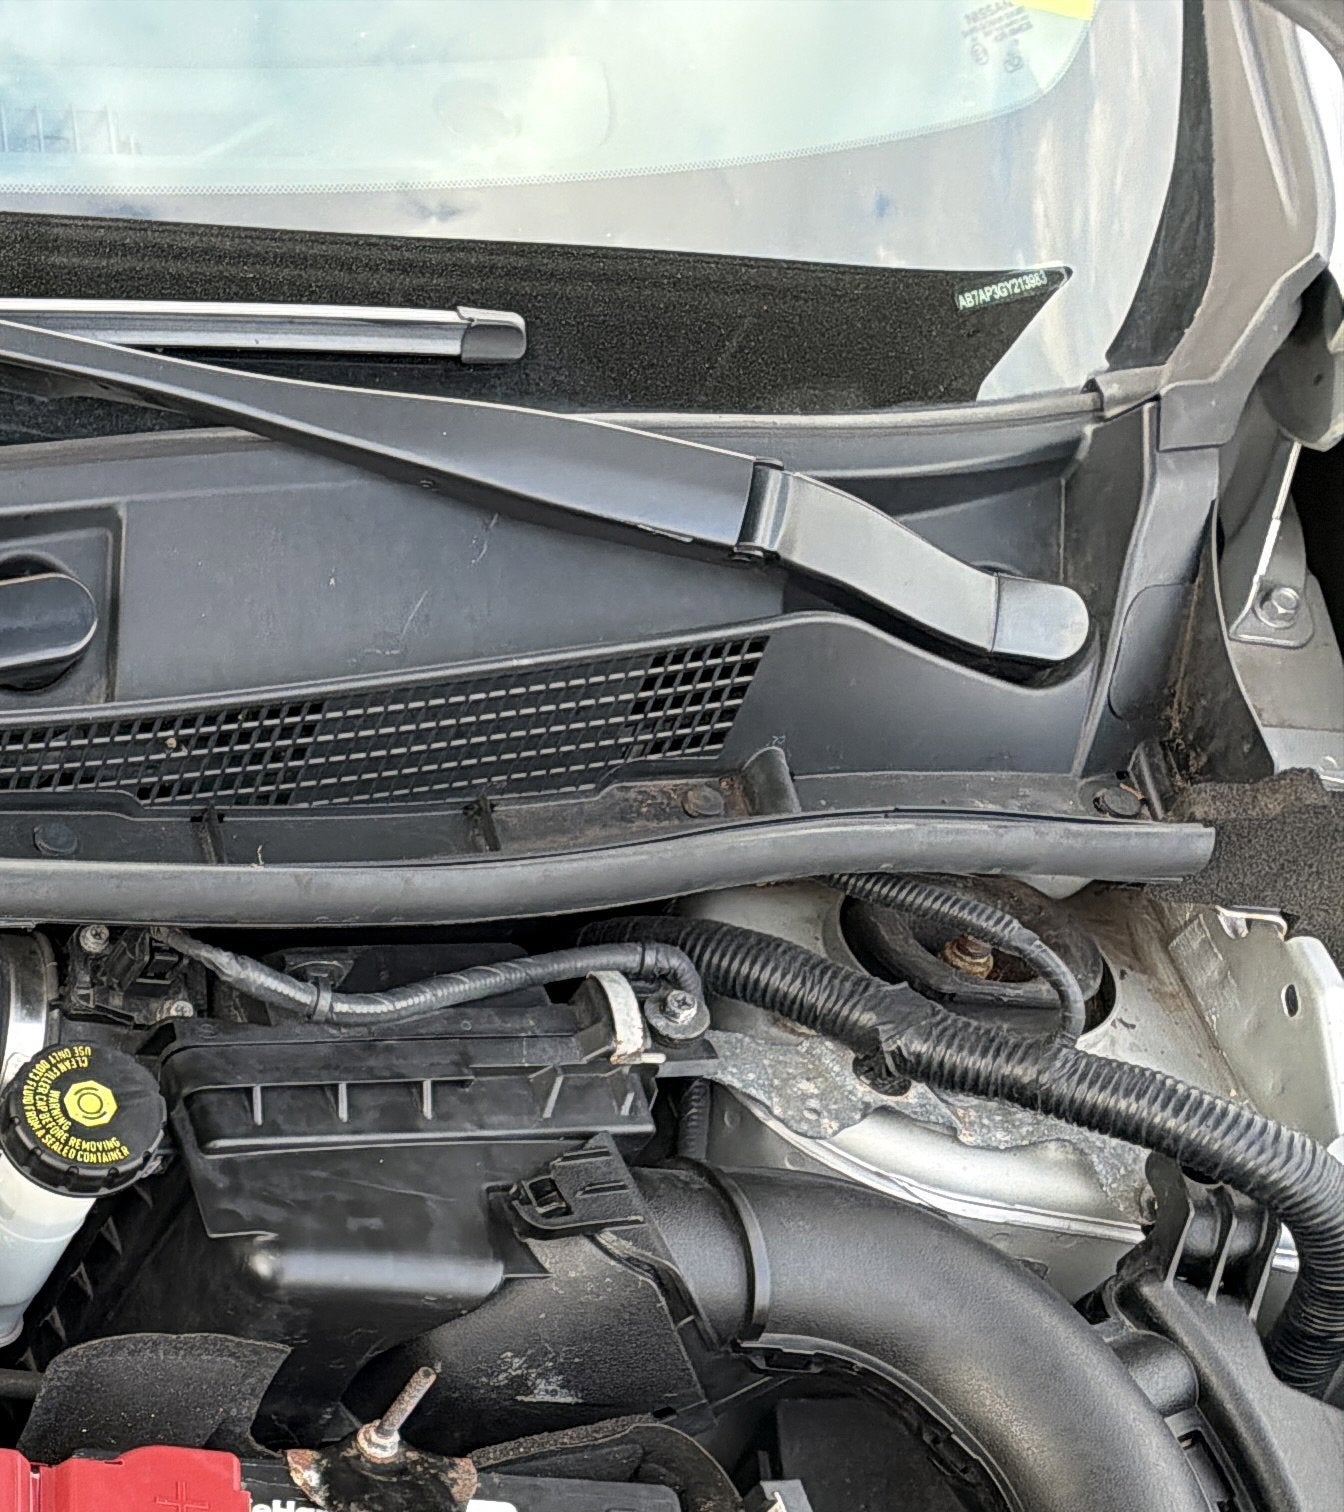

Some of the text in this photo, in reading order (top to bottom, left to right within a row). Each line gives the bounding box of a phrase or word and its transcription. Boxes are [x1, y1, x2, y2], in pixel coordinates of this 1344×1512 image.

[49, 1048, 72, 1065] ONLY
[73, 1046, 92, 1057] USE
[22, 1080, 37, 1105] FLUID
[35, 1056, 121, 1152] CLEAN FILLER CAP BEFORE REMOVING
[24, 1105, 42, 1131] FROM
[48, 1090, 72, 1131] WARNING
[35, 1129, 44, 1138] A
[41, 1134, 75, 1159] SEALED
[77, 1146, 130, 1164] CONTAINER
